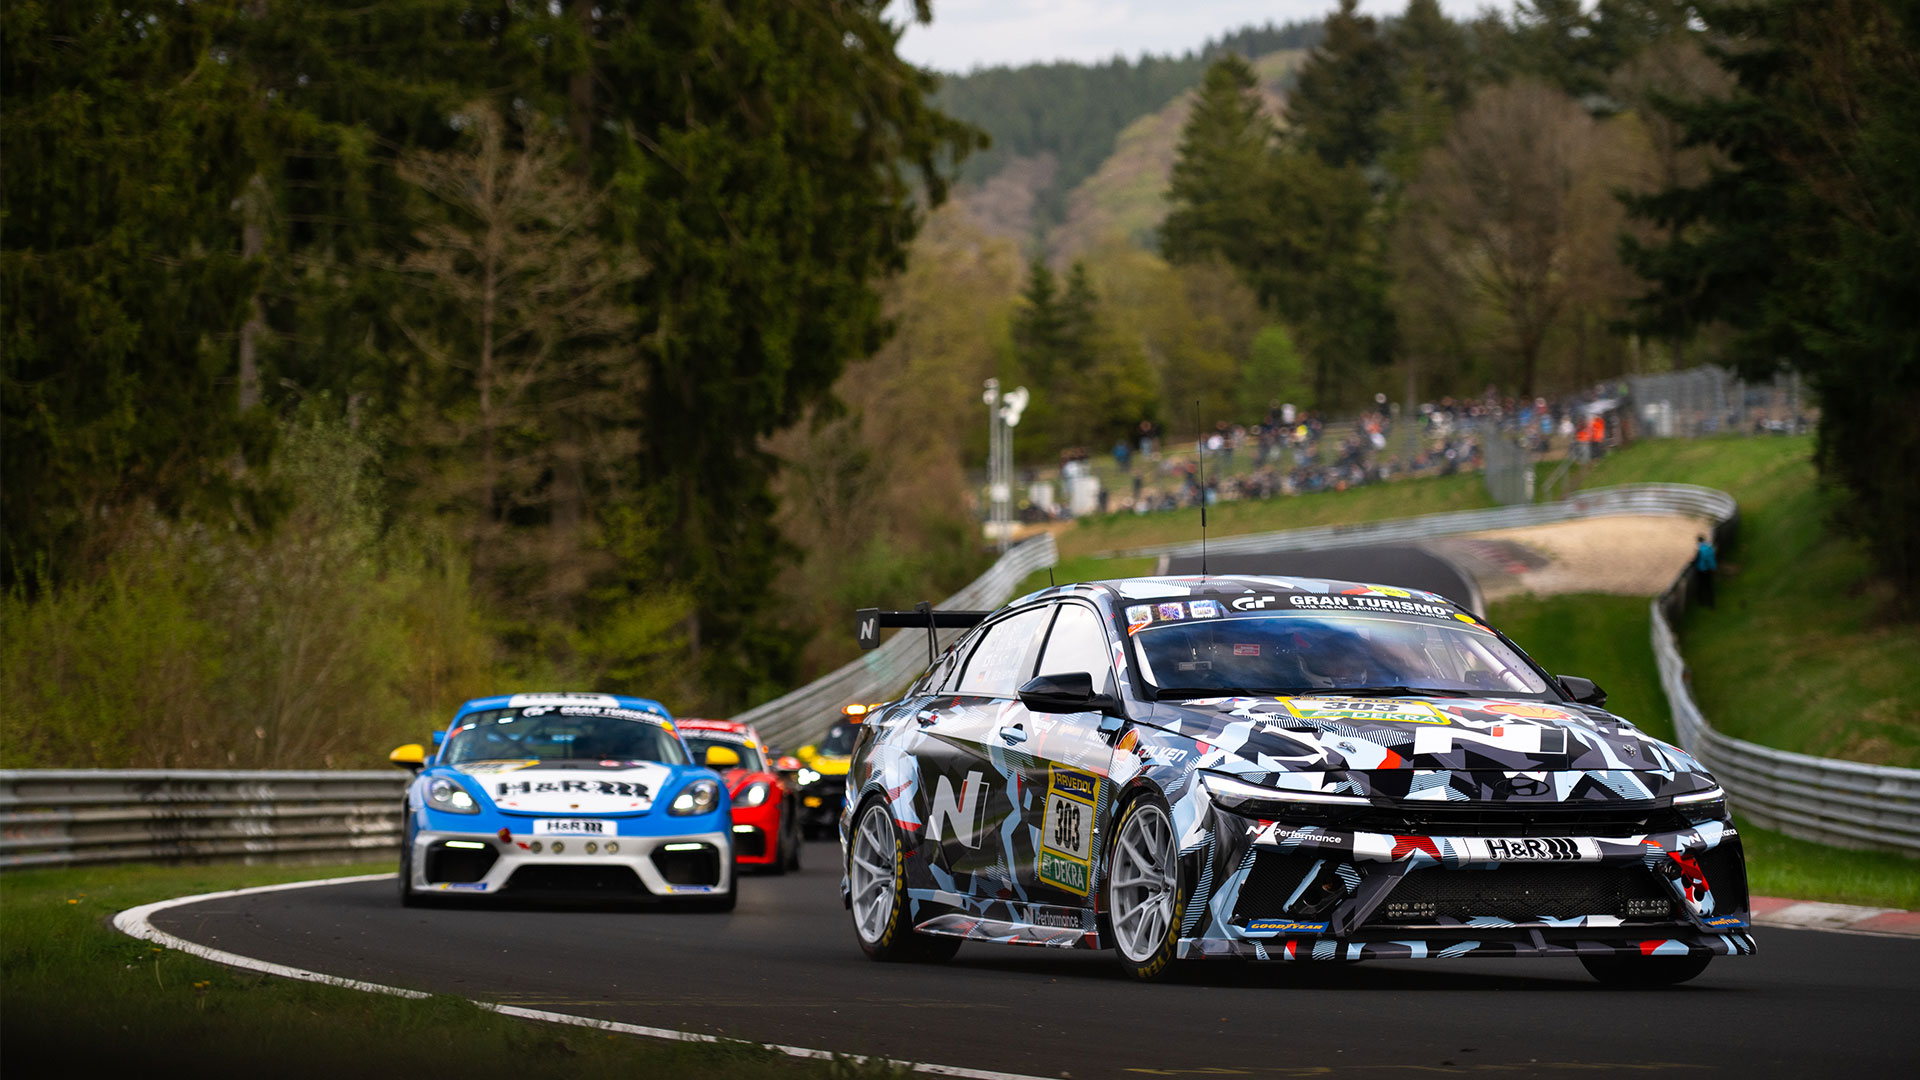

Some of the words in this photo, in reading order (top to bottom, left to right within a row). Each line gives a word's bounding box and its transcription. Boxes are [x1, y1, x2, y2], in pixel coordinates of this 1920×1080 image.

[1289, 595, 1349, 606] GRAN
[1352, 597, 1447, 615] TURISMO
[1392, 608, 1452, 620] SIMULATOR
[1322, 701, 1400, 712] 303
[1351, 711, 1439, 723] DEKRA
[1138, 745, 1188, 762] FALKEN
[1055, 772, 1093, 795] RAVENOL
[547, 821, 581, 832] H&R
[1054, 799, 1081, 852] 303
[1274, 828, 1342, 844] Performance
[1484, 839, 1548, 859] H&R
[1054, 858, 1085, 890] DEKRA
[1035, 911, 1079, 928] Performance
